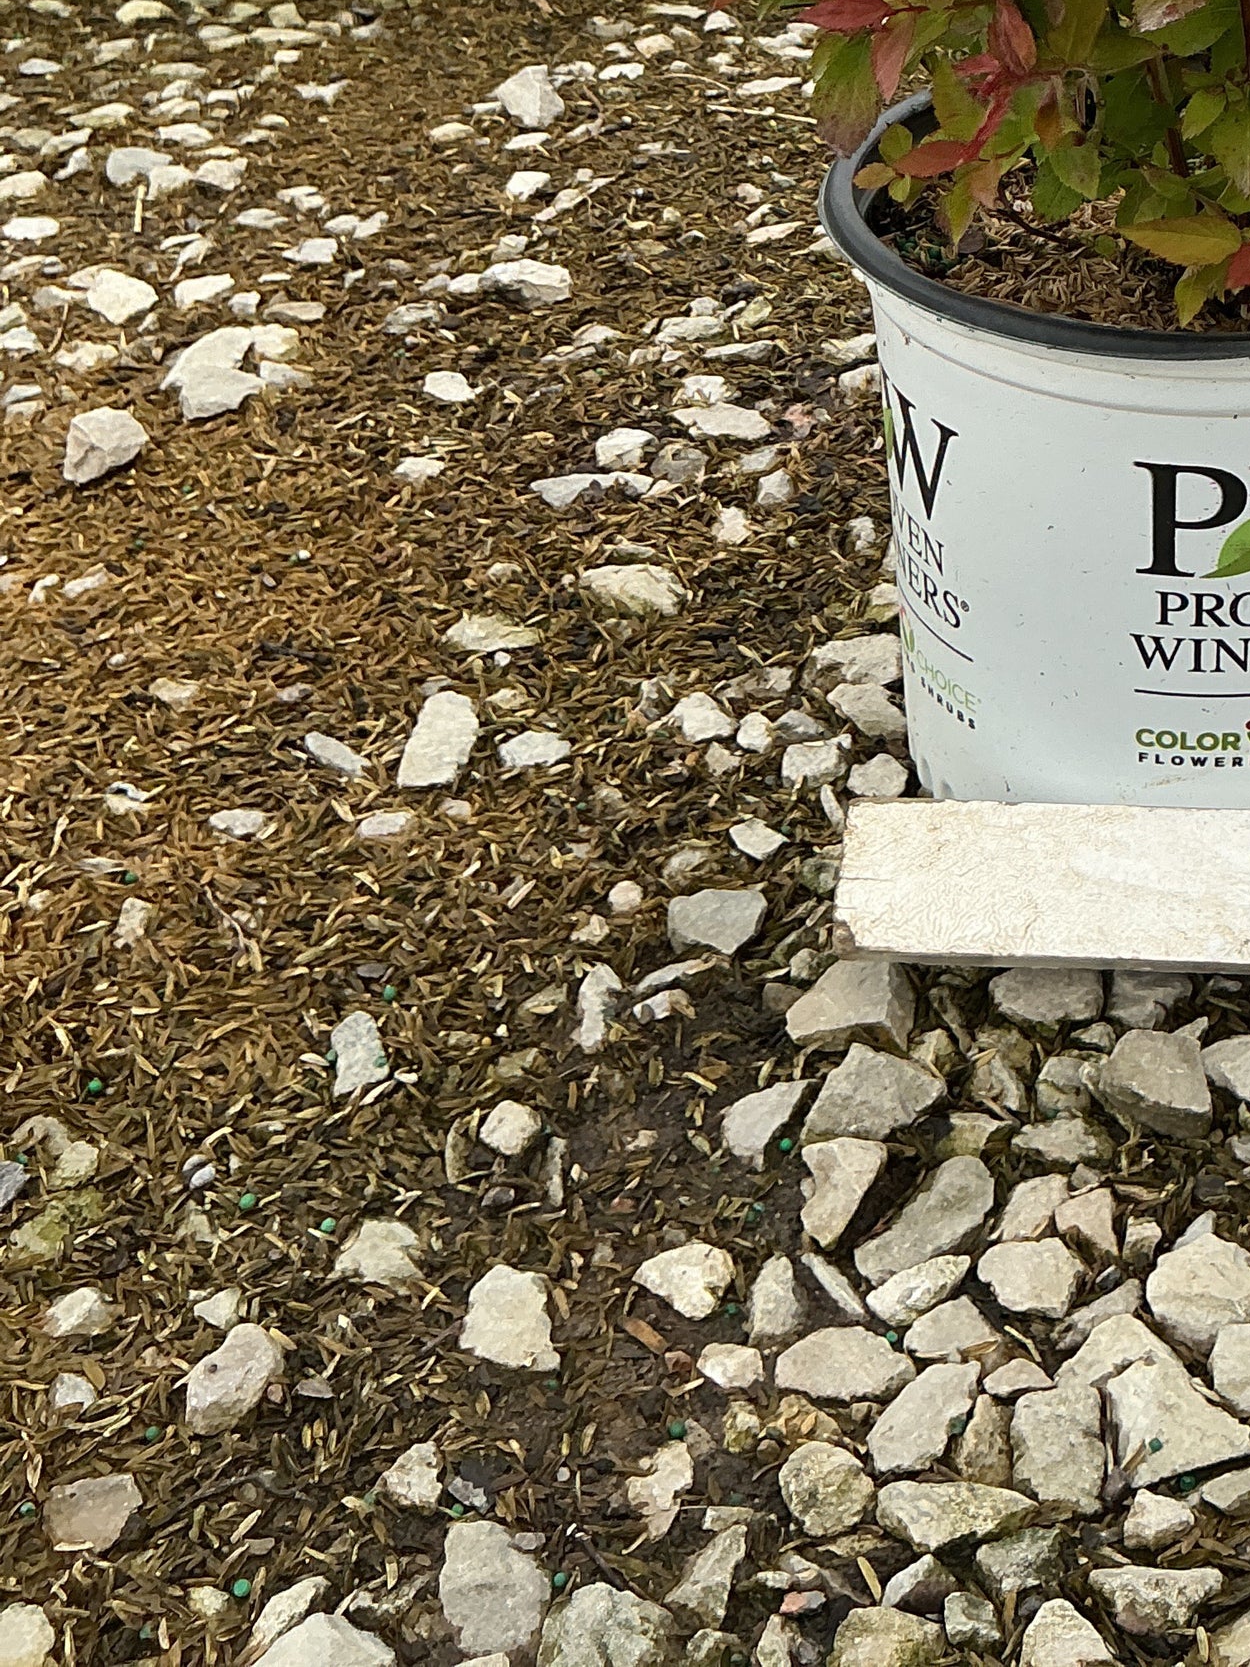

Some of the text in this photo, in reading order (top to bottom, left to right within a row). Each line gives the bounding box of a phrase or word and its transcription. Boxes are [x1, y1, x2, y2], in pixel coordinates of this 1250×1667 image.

[880, 365, 960, 522] W
[916, 649, 978, 714] CHOICE
[1135, 728, 1242, 752] COLOR
